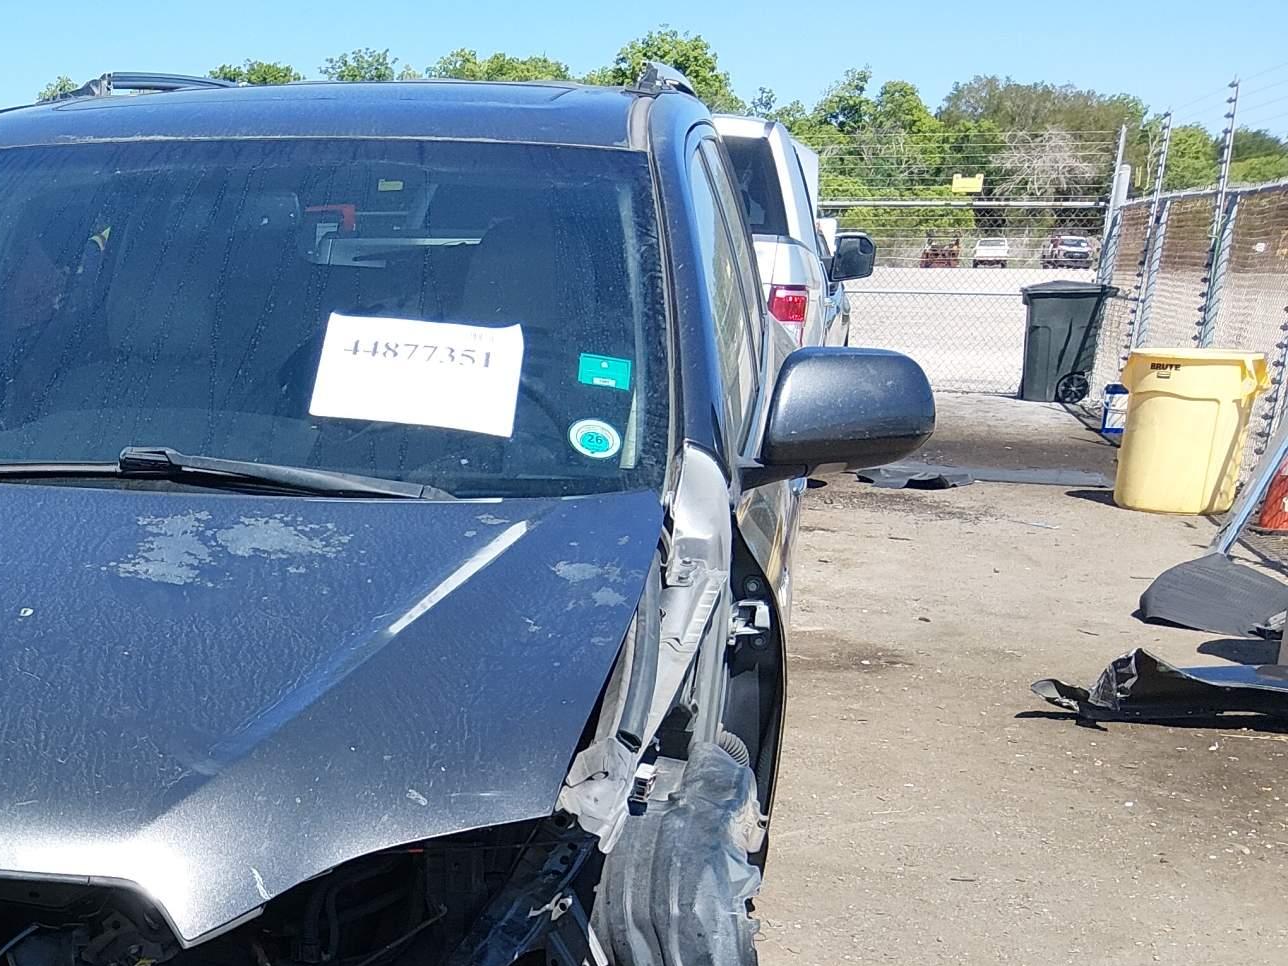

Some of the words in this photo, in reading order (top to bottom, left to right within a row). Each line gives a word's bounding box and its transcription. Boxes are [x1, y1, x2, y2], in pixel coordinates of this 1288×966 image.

[343, 339, 491, 368] 44877351
[1151, 363, 1181, 371] BRUTE
[587, 434, 603, 445] 26
